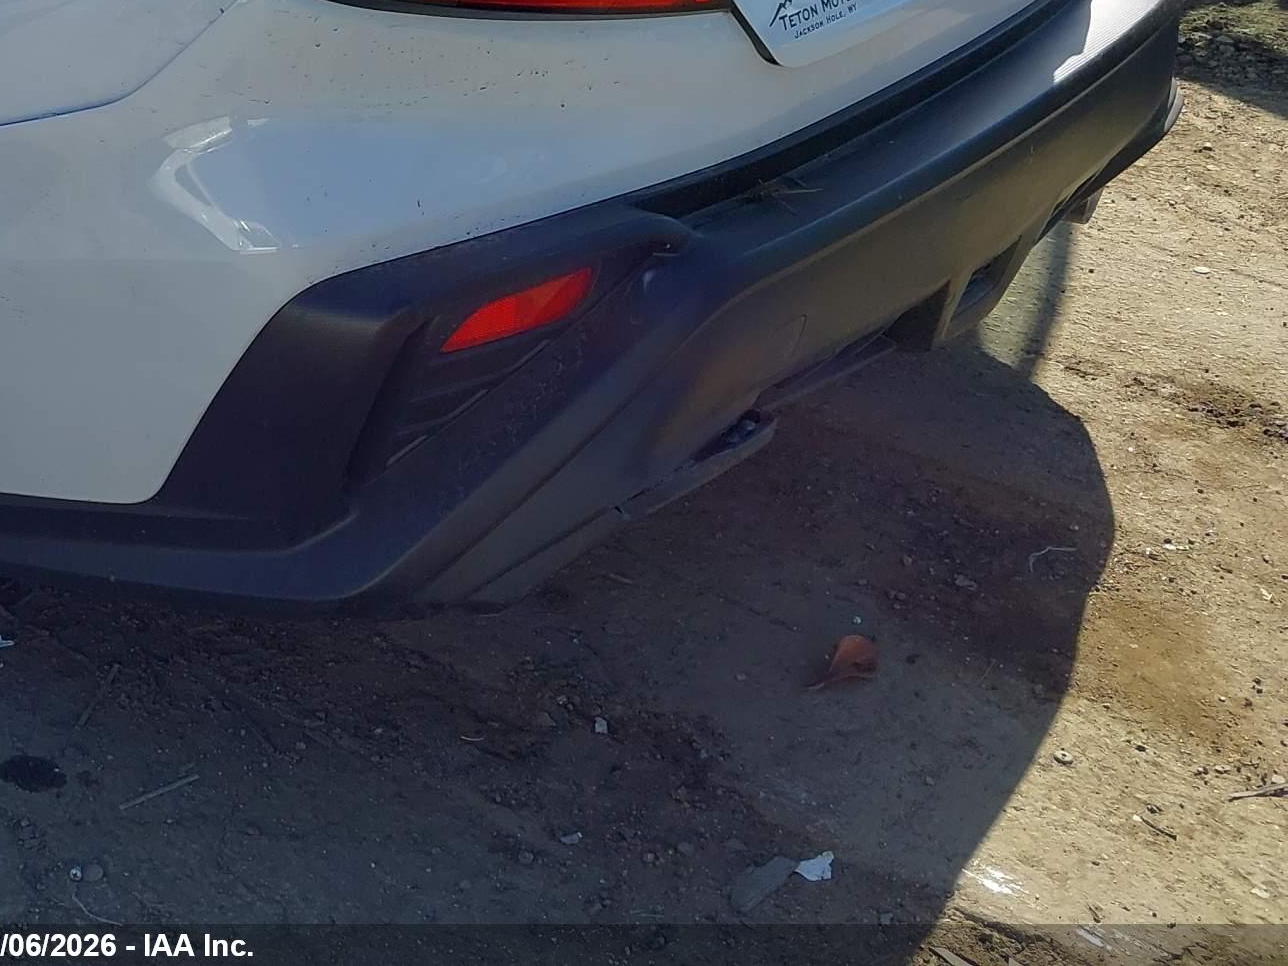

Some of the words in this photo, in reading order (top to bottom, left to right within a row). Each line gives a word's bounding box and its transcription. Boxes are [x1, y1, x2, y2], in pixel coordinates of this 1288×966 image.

[779, 4, 819, 30] TETON
[794, 20, 824, 39] JACKSON
[847, 3, 857, 14] WY
